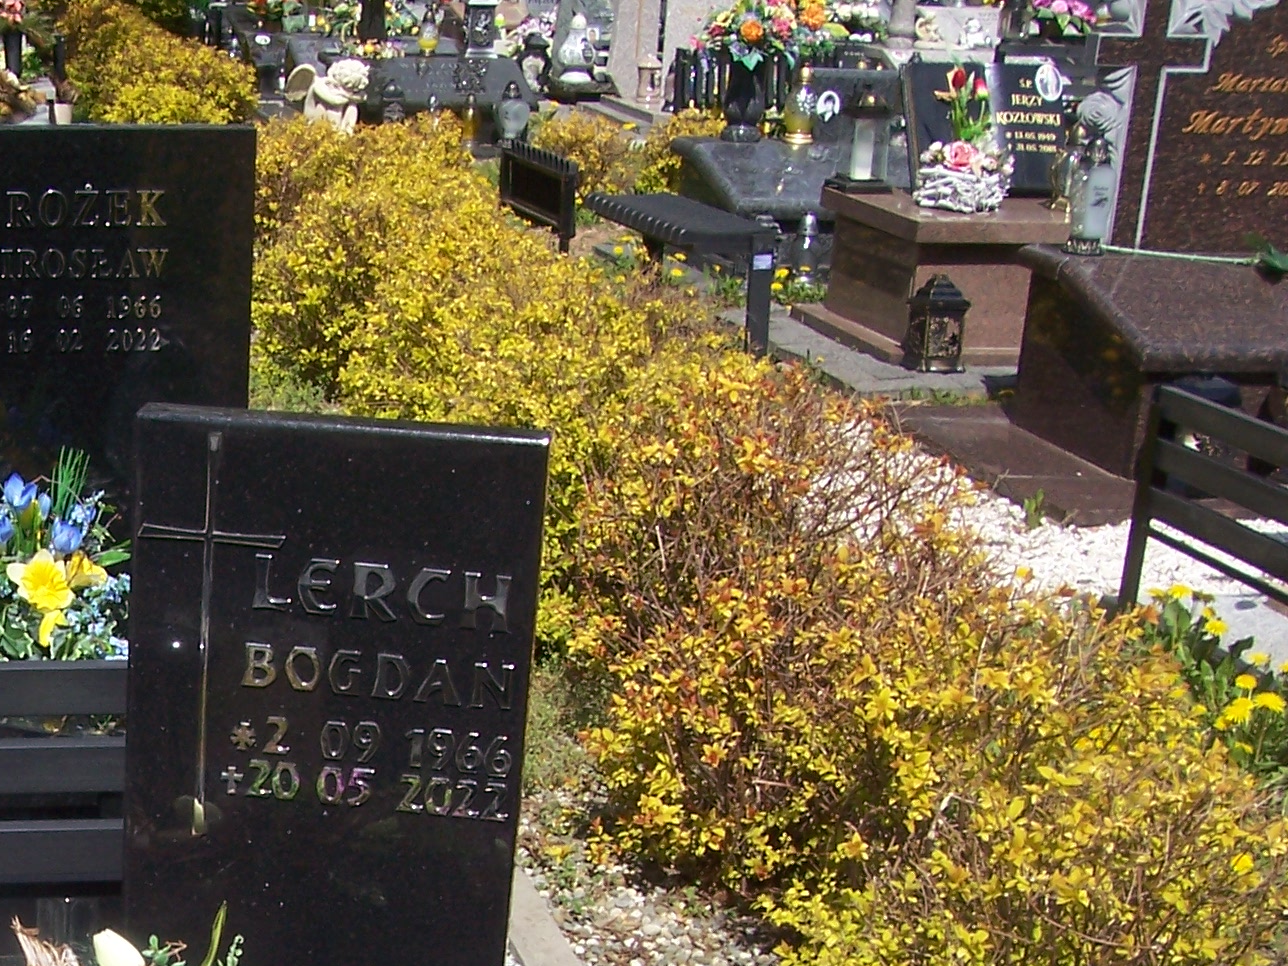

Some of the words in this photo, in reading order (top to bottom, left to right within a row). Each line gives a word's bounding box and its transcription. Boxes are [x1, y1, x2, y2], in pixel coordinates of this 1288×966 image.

[996, 111, 1061, 127] KOZŁOWSKI
[1011, 94, 1043, 107] JERZY
[106, 295, 162, 319] 1966
[106, 327, 162, 351] 2022
[251, 553, 513, 633] LERCH
[241, 641, 515, 710] BOGDAN
[320, 720, 381, 763] 09
[406, 727, 511, 777] 1966
[248, 759, 300, 800] 20
[316, 767, 376, 806] 05
[396, 774, 510, 823] 2022
